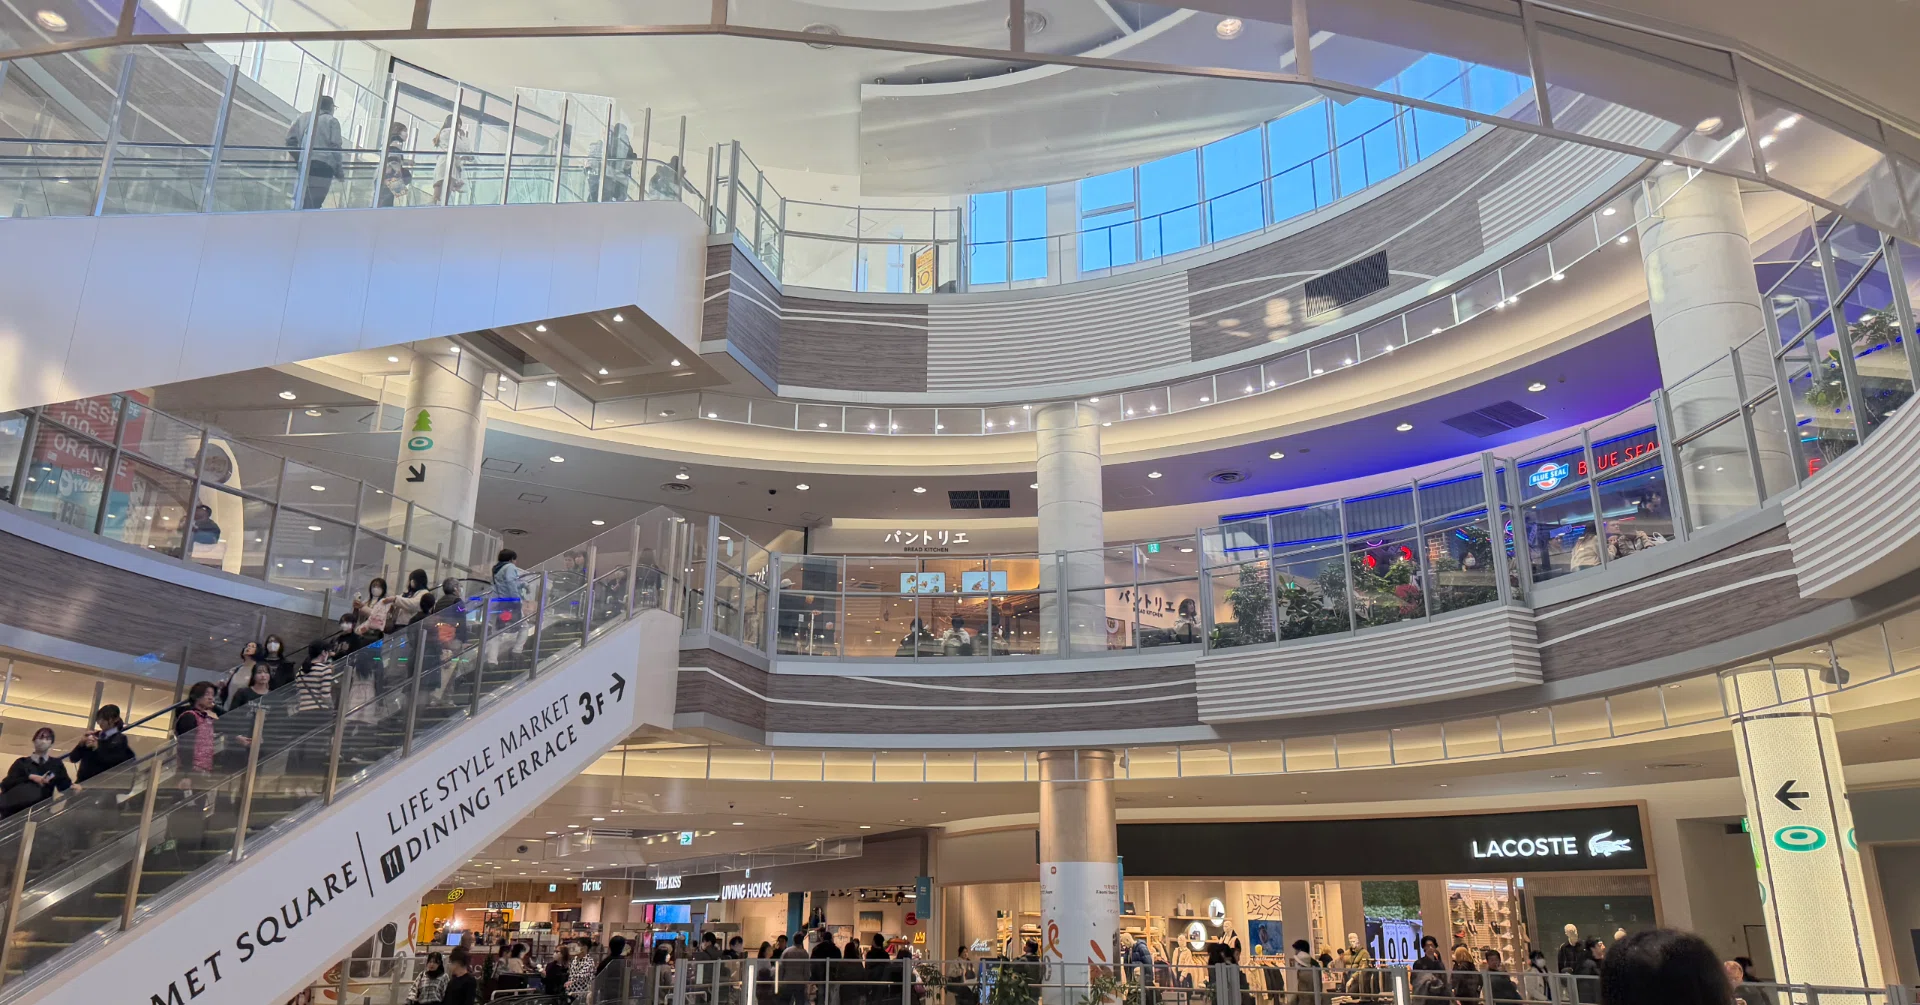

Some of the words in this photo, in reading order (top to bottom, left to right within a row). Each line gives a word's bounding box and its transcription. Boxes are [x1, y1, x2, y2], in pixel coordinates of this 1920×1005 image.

[72, 398, 119, 427] RESH
[53, 433, 129, 478] ORANE
[1578, 451, 1619, 475] BUE
[1624, 441, 1662, 462] SEA
[1532, 472, 1549, 483] BLUE
[1550, 468, 1567, 478] SEAL
[884, 529, 970, 546] パントリエ
[387, 787, 434, 836] LIFE
[435, 746, 496, 802] STYLE
[499, 693, 570, 760] MARKET
[578, 691, 605, 726] 3F
[405, 787, 491, 863] DINING
[493, 724, 578, 797] TERRACE
[1472, 836, 1579, 859] LACOSTE
[656, 876, 668, 890] THE
[668, 875, 682, 889] KISS
[721, 883, 746, 900] LIVING
[236, 860, 358, 963] SQUARE
